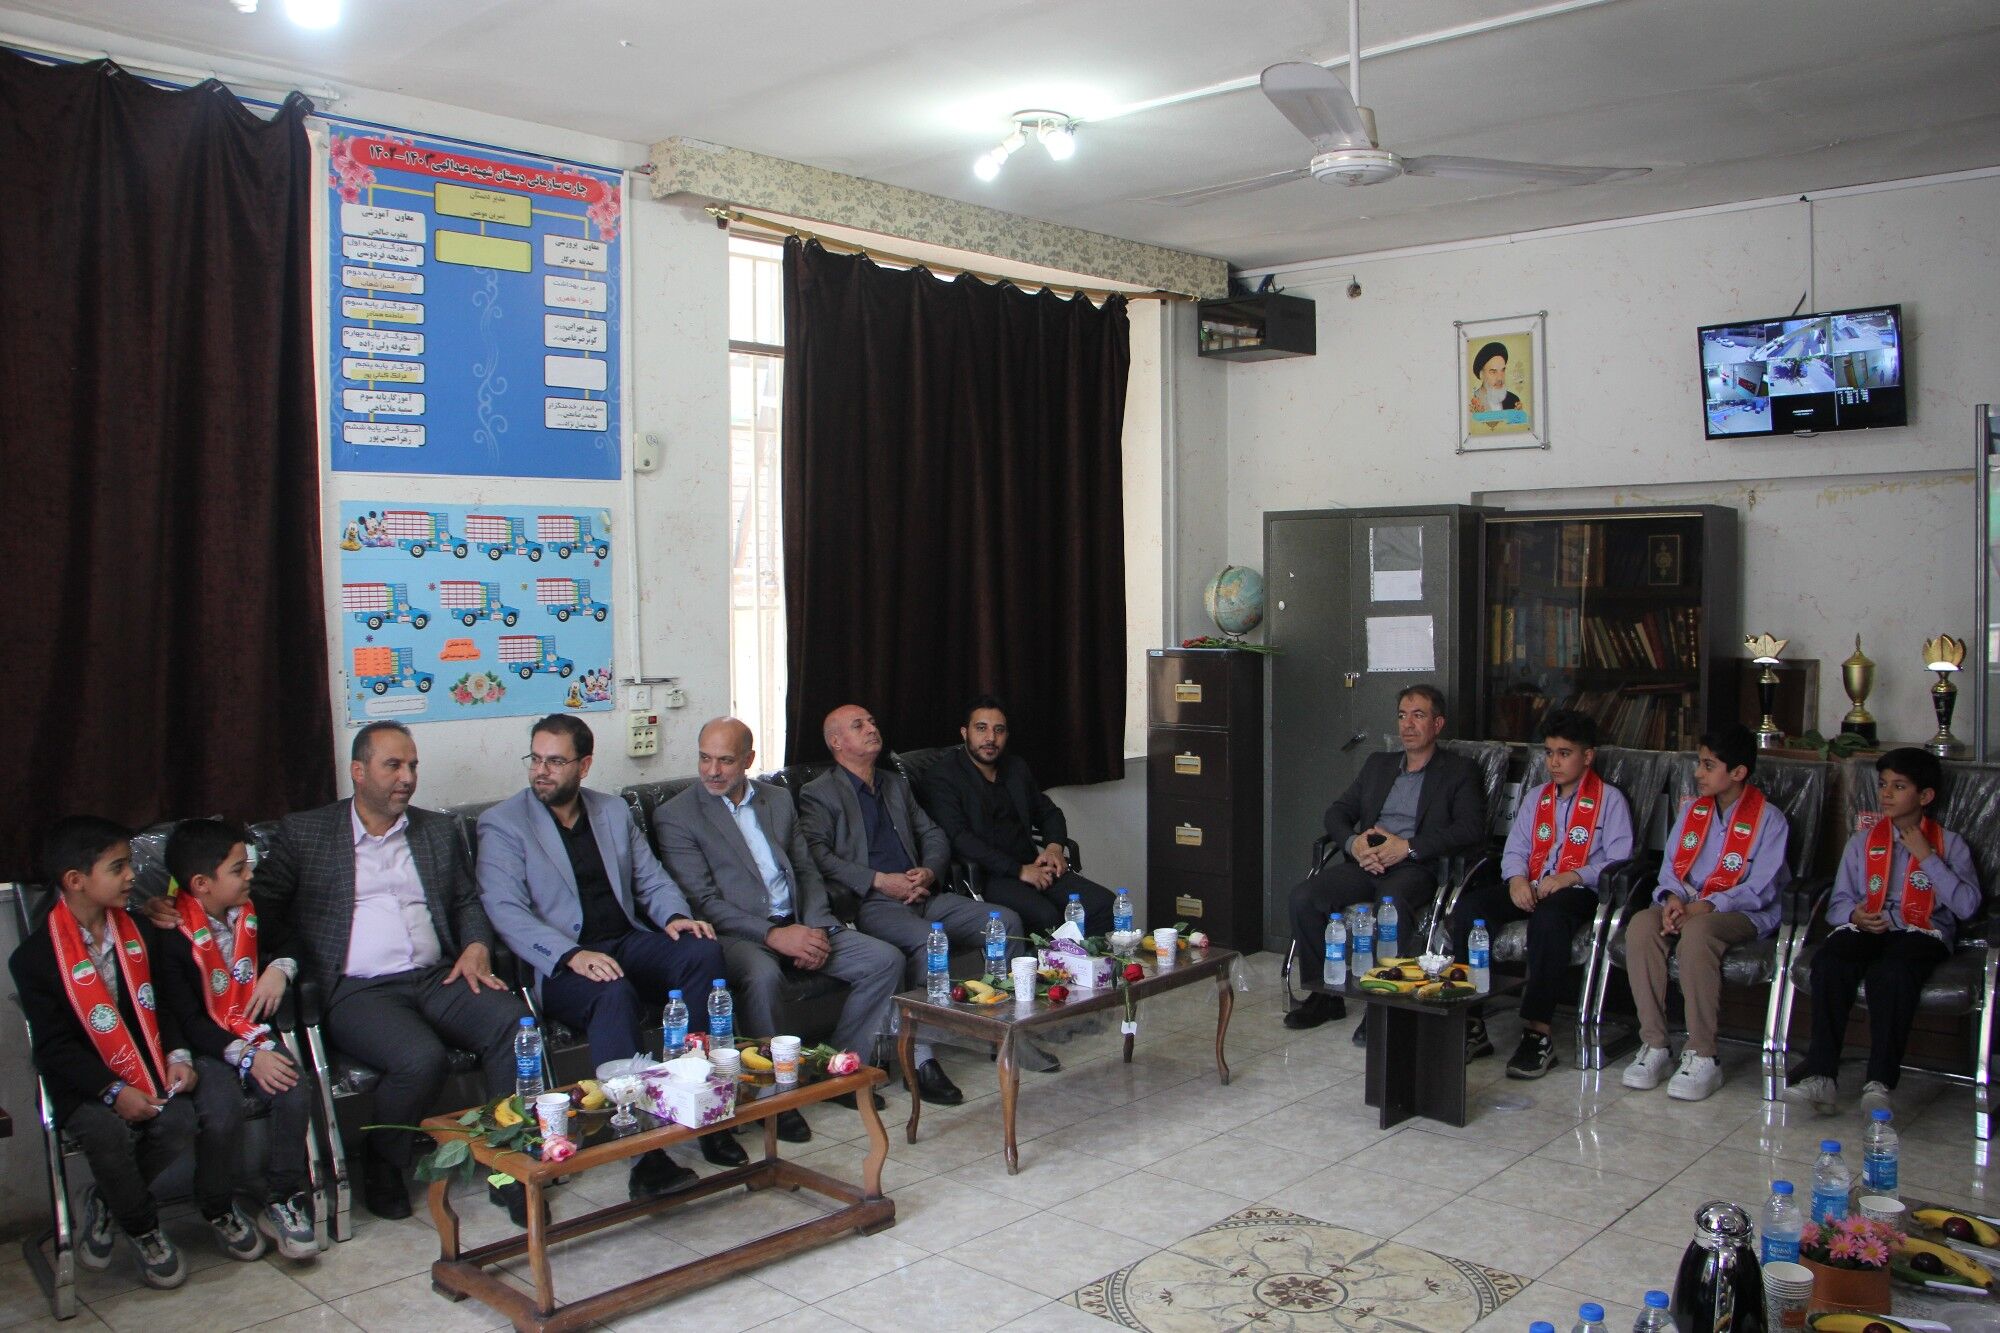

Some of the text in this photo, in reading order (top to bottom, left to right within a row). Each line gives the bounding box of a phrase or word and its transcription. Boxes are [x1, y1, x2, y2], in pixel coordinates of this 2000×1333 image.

[471, 165, 493, 179] شهید
[495, 169, 525, 185] دبستان
[527, 175, 561, 191] سازمانی
[563, 182, 587, 197] چارت
